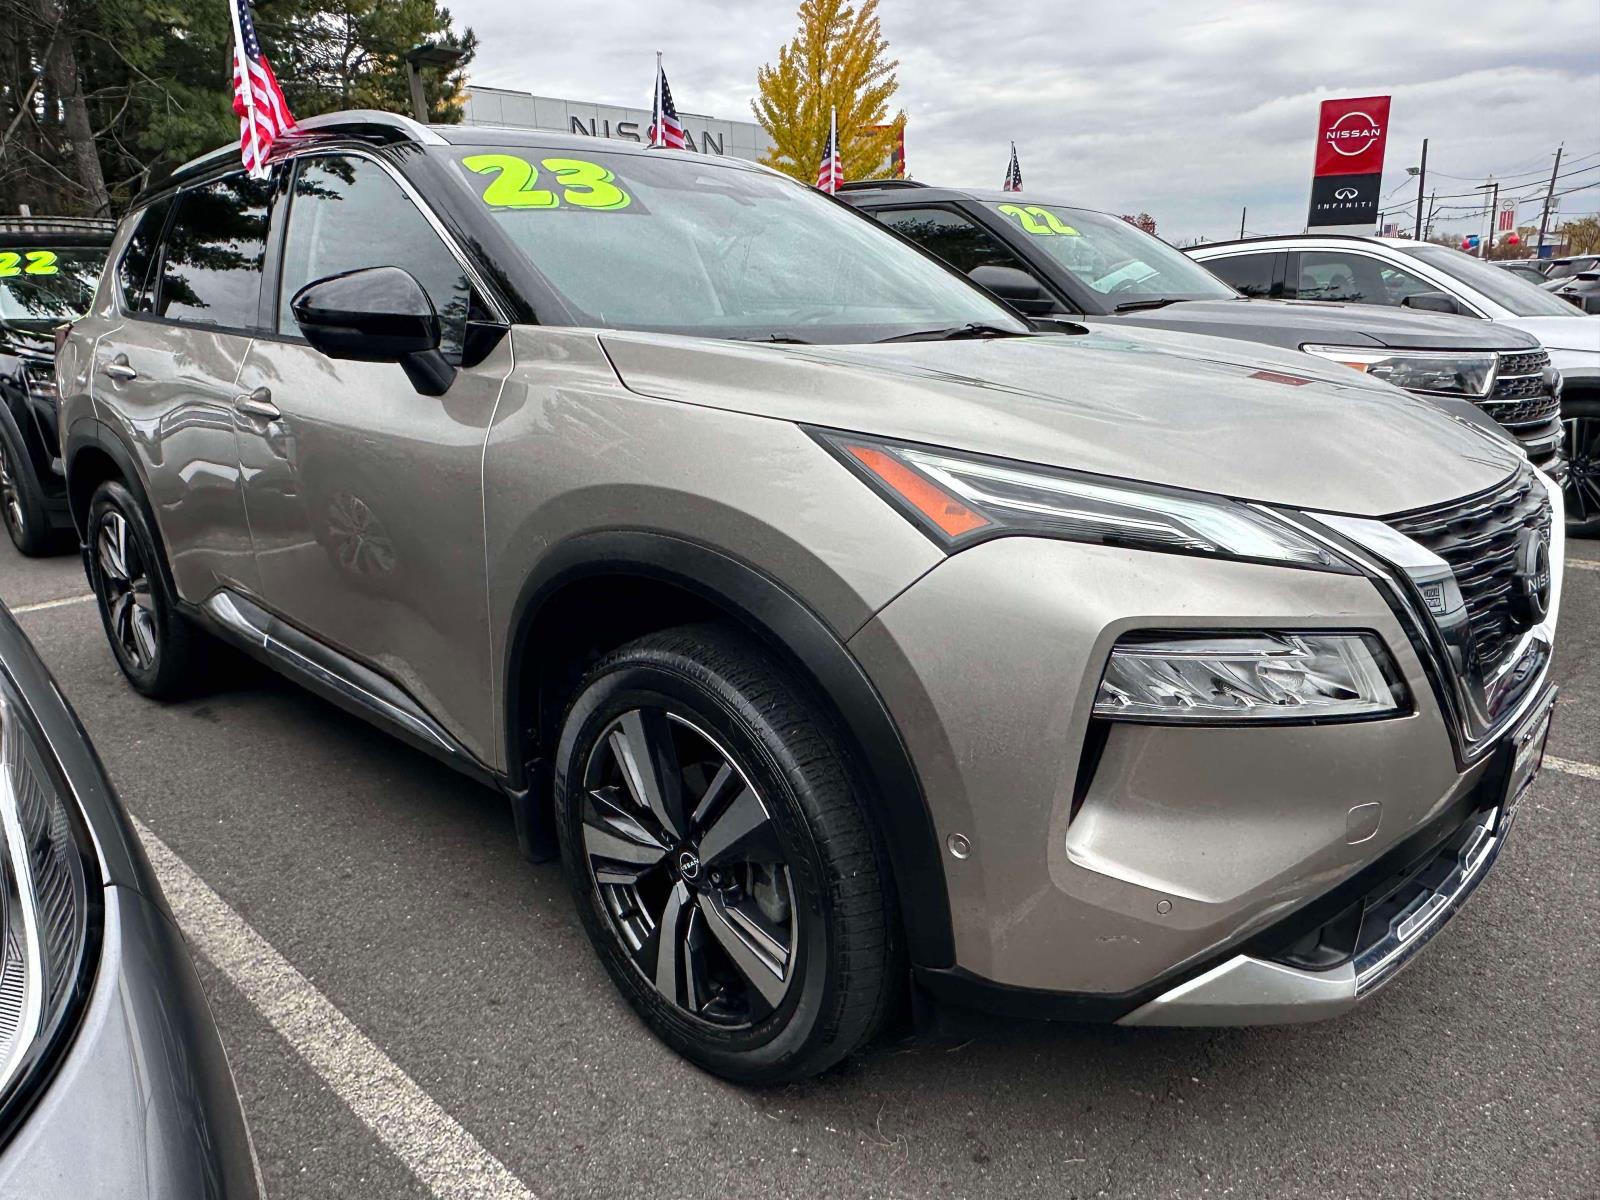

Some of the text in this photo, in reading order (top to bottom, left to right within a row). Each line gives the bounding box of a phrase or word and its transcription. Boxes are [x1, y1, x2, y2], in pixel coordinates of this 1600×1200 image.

[569, 115, 724, 156] NISAN
[1326, 128, 1381, 140] NISSAN
[461, 153, 632, 211] 23
[997, 204, 1081, 237] 22
[1317, 201, 1372, 210] INFINITI
